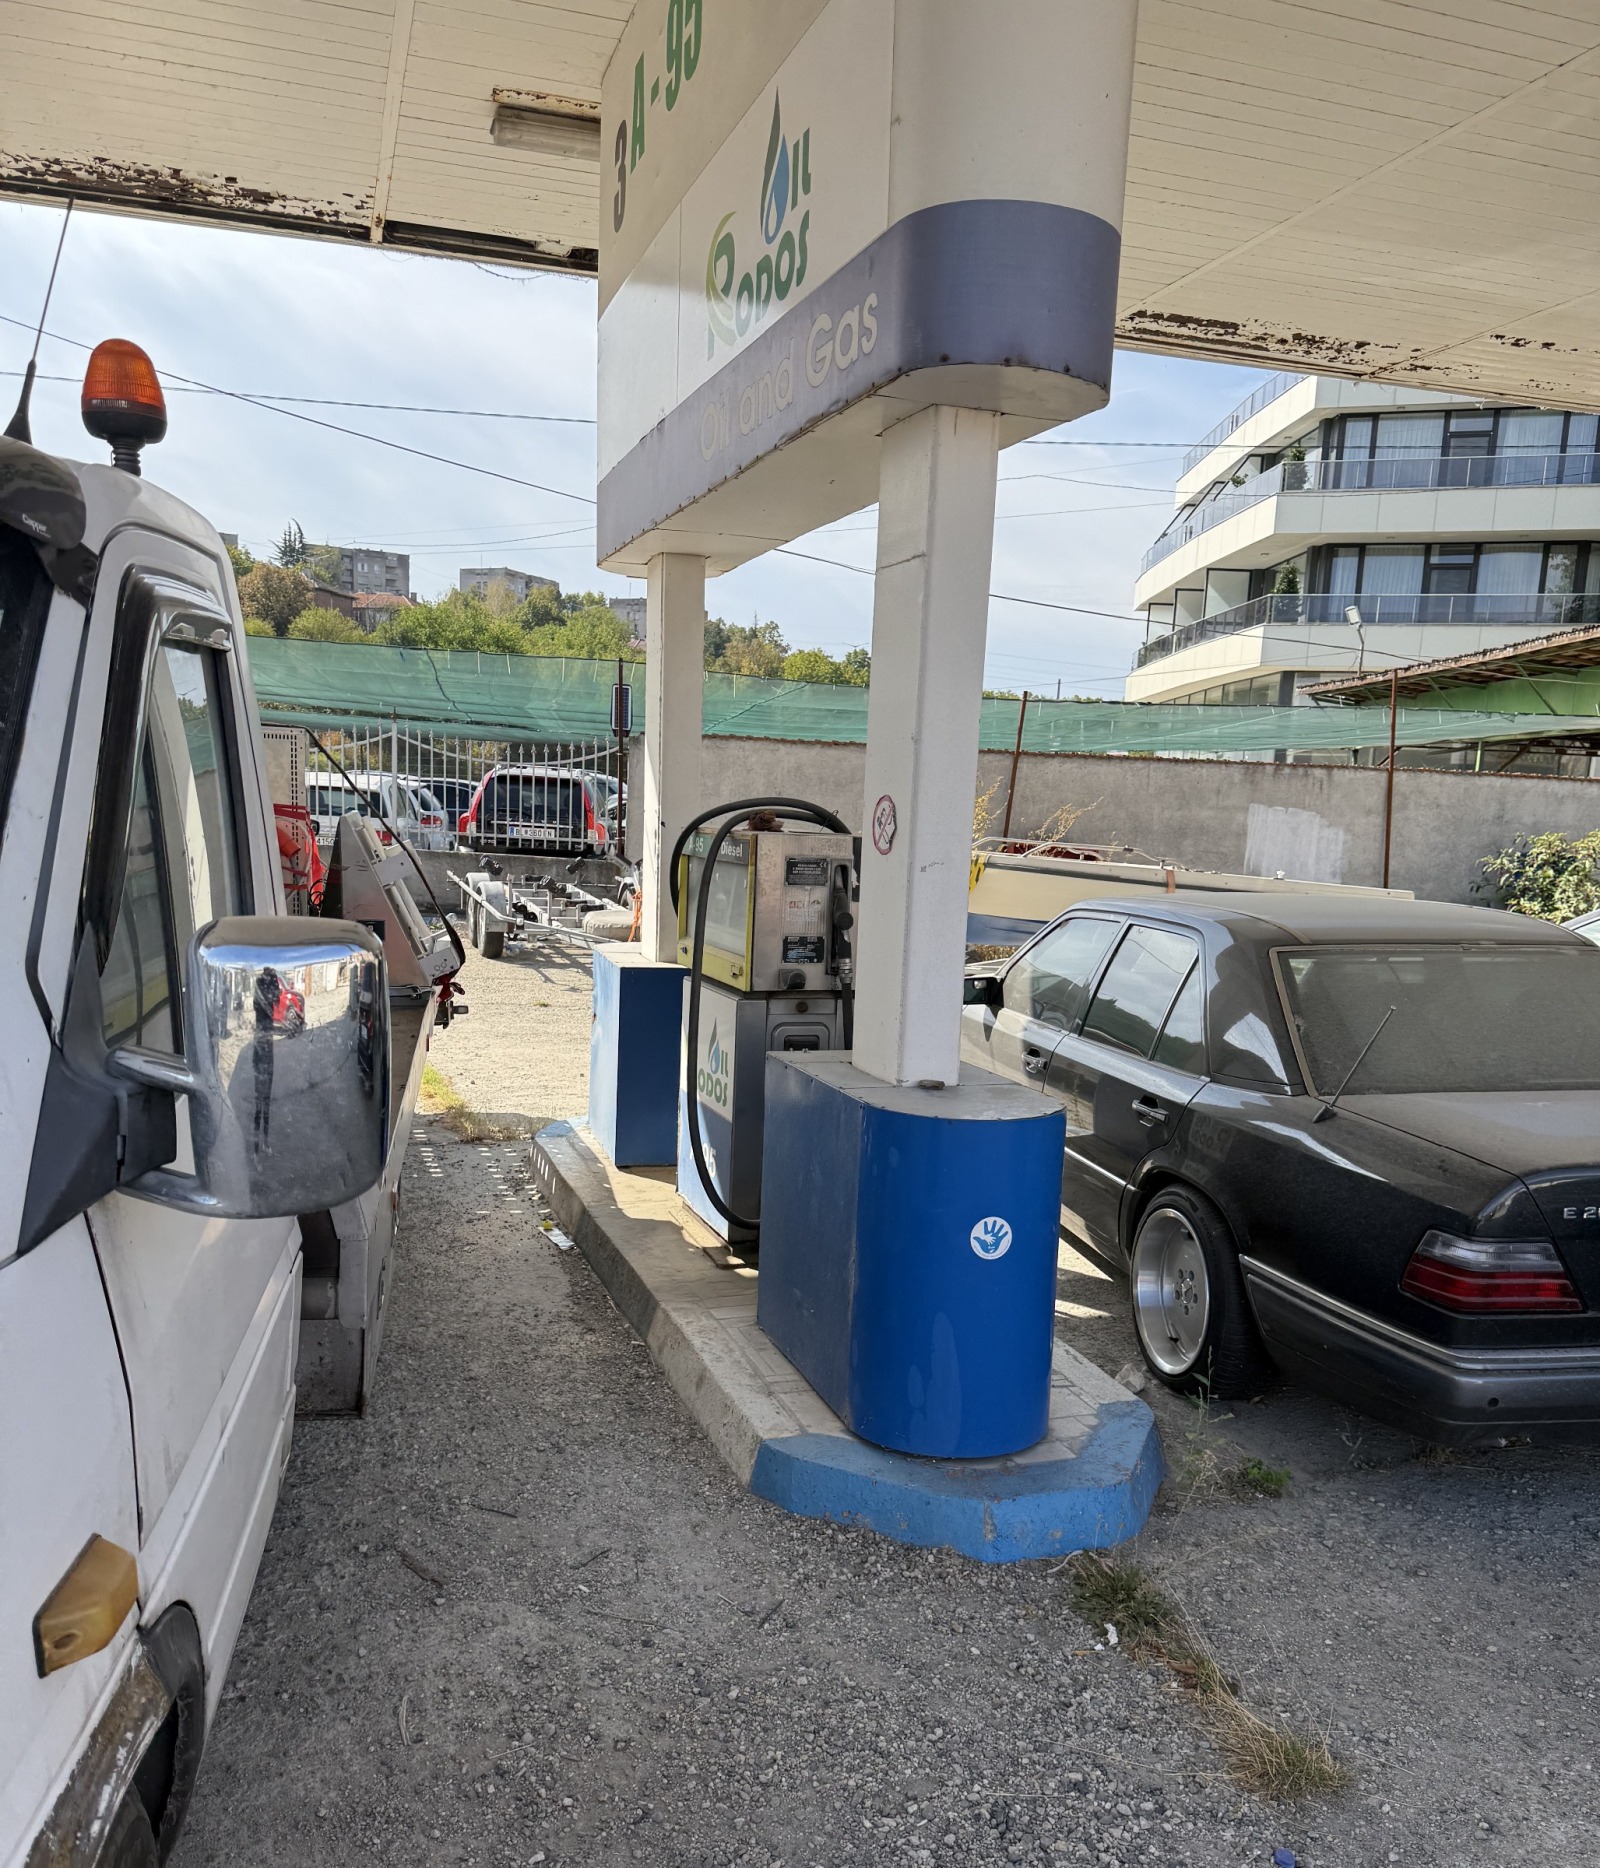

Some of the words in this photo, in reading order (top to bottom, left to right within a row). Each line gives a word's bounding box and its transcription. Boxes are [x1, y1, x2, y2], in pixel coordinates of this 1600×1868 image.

[613, 119, 628, 234] 3
[630, 0, 703, 175] A-95
[700, 391, 731, 462] Oil
[739, 337, 796, 437] and
[805, 292, 879, 388] Gas
[720, 841, 743, 858] Diesel
[697, 1067, 728, 1108] ODOS
[1563, 1207, 1577, 1219] E
[1583, 1206, 1600, 1219] 2
